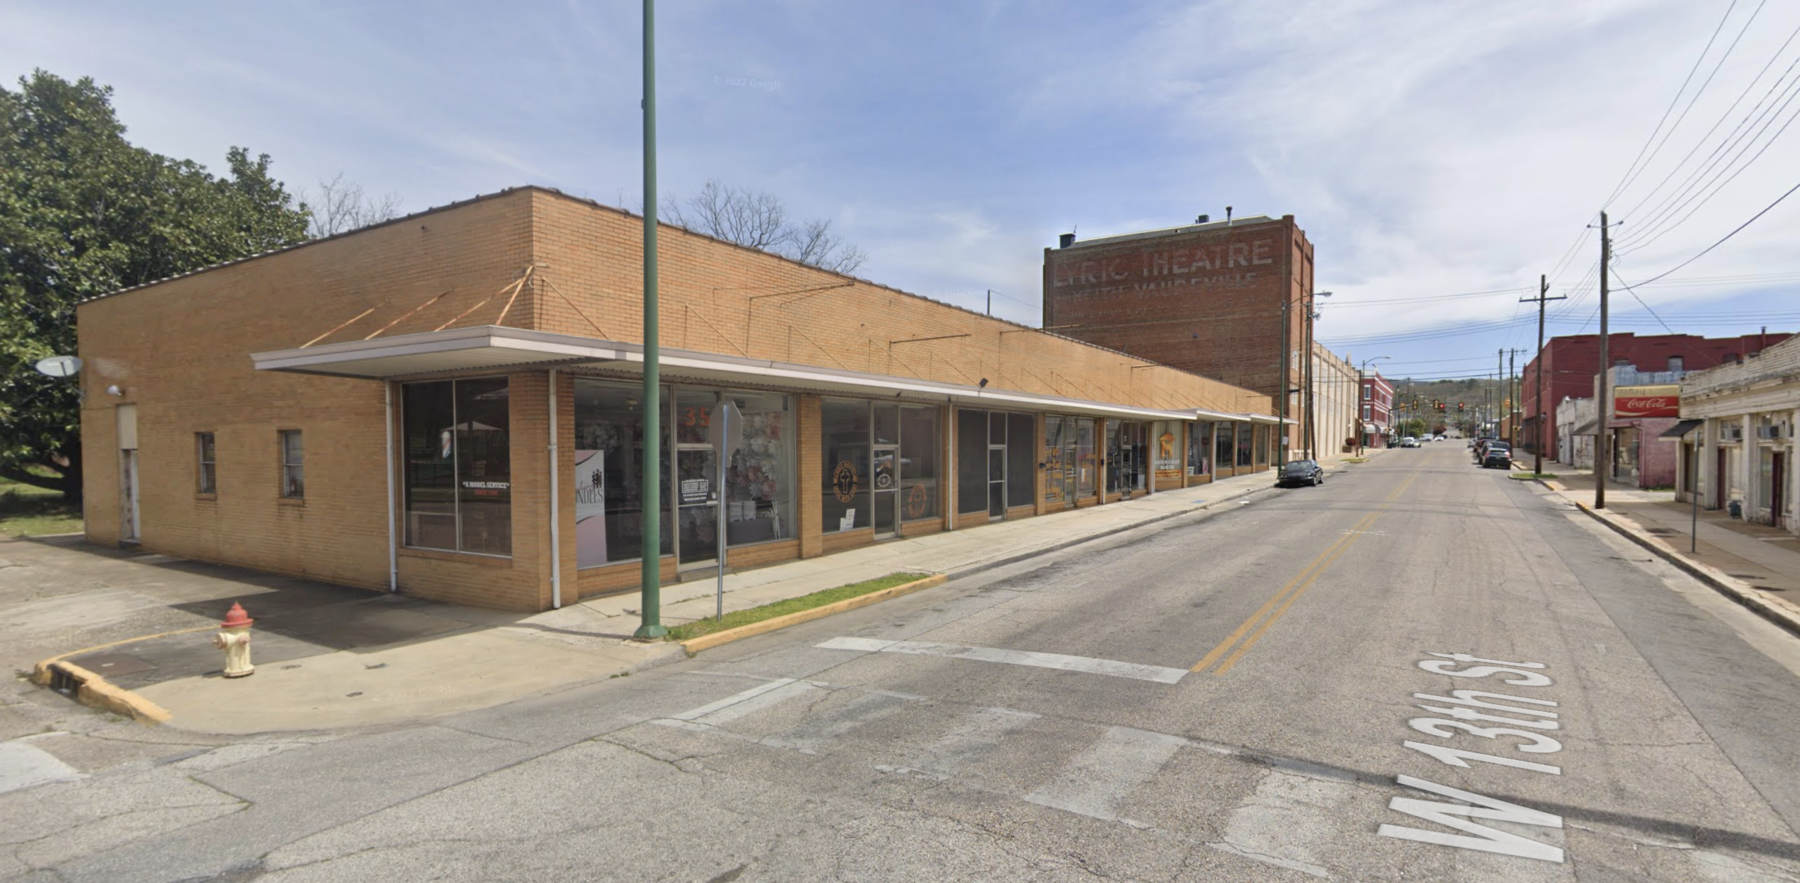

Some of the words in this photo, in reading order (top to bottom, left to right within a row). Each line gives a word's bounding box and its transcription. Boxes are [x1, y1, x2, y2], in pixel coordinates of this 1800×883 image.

[1053, 257, 1129, 287] LYRIC
[1142, 239, 1273, 278] THEATRE
[1627, 398, 1667, 409] Coca-Cola
